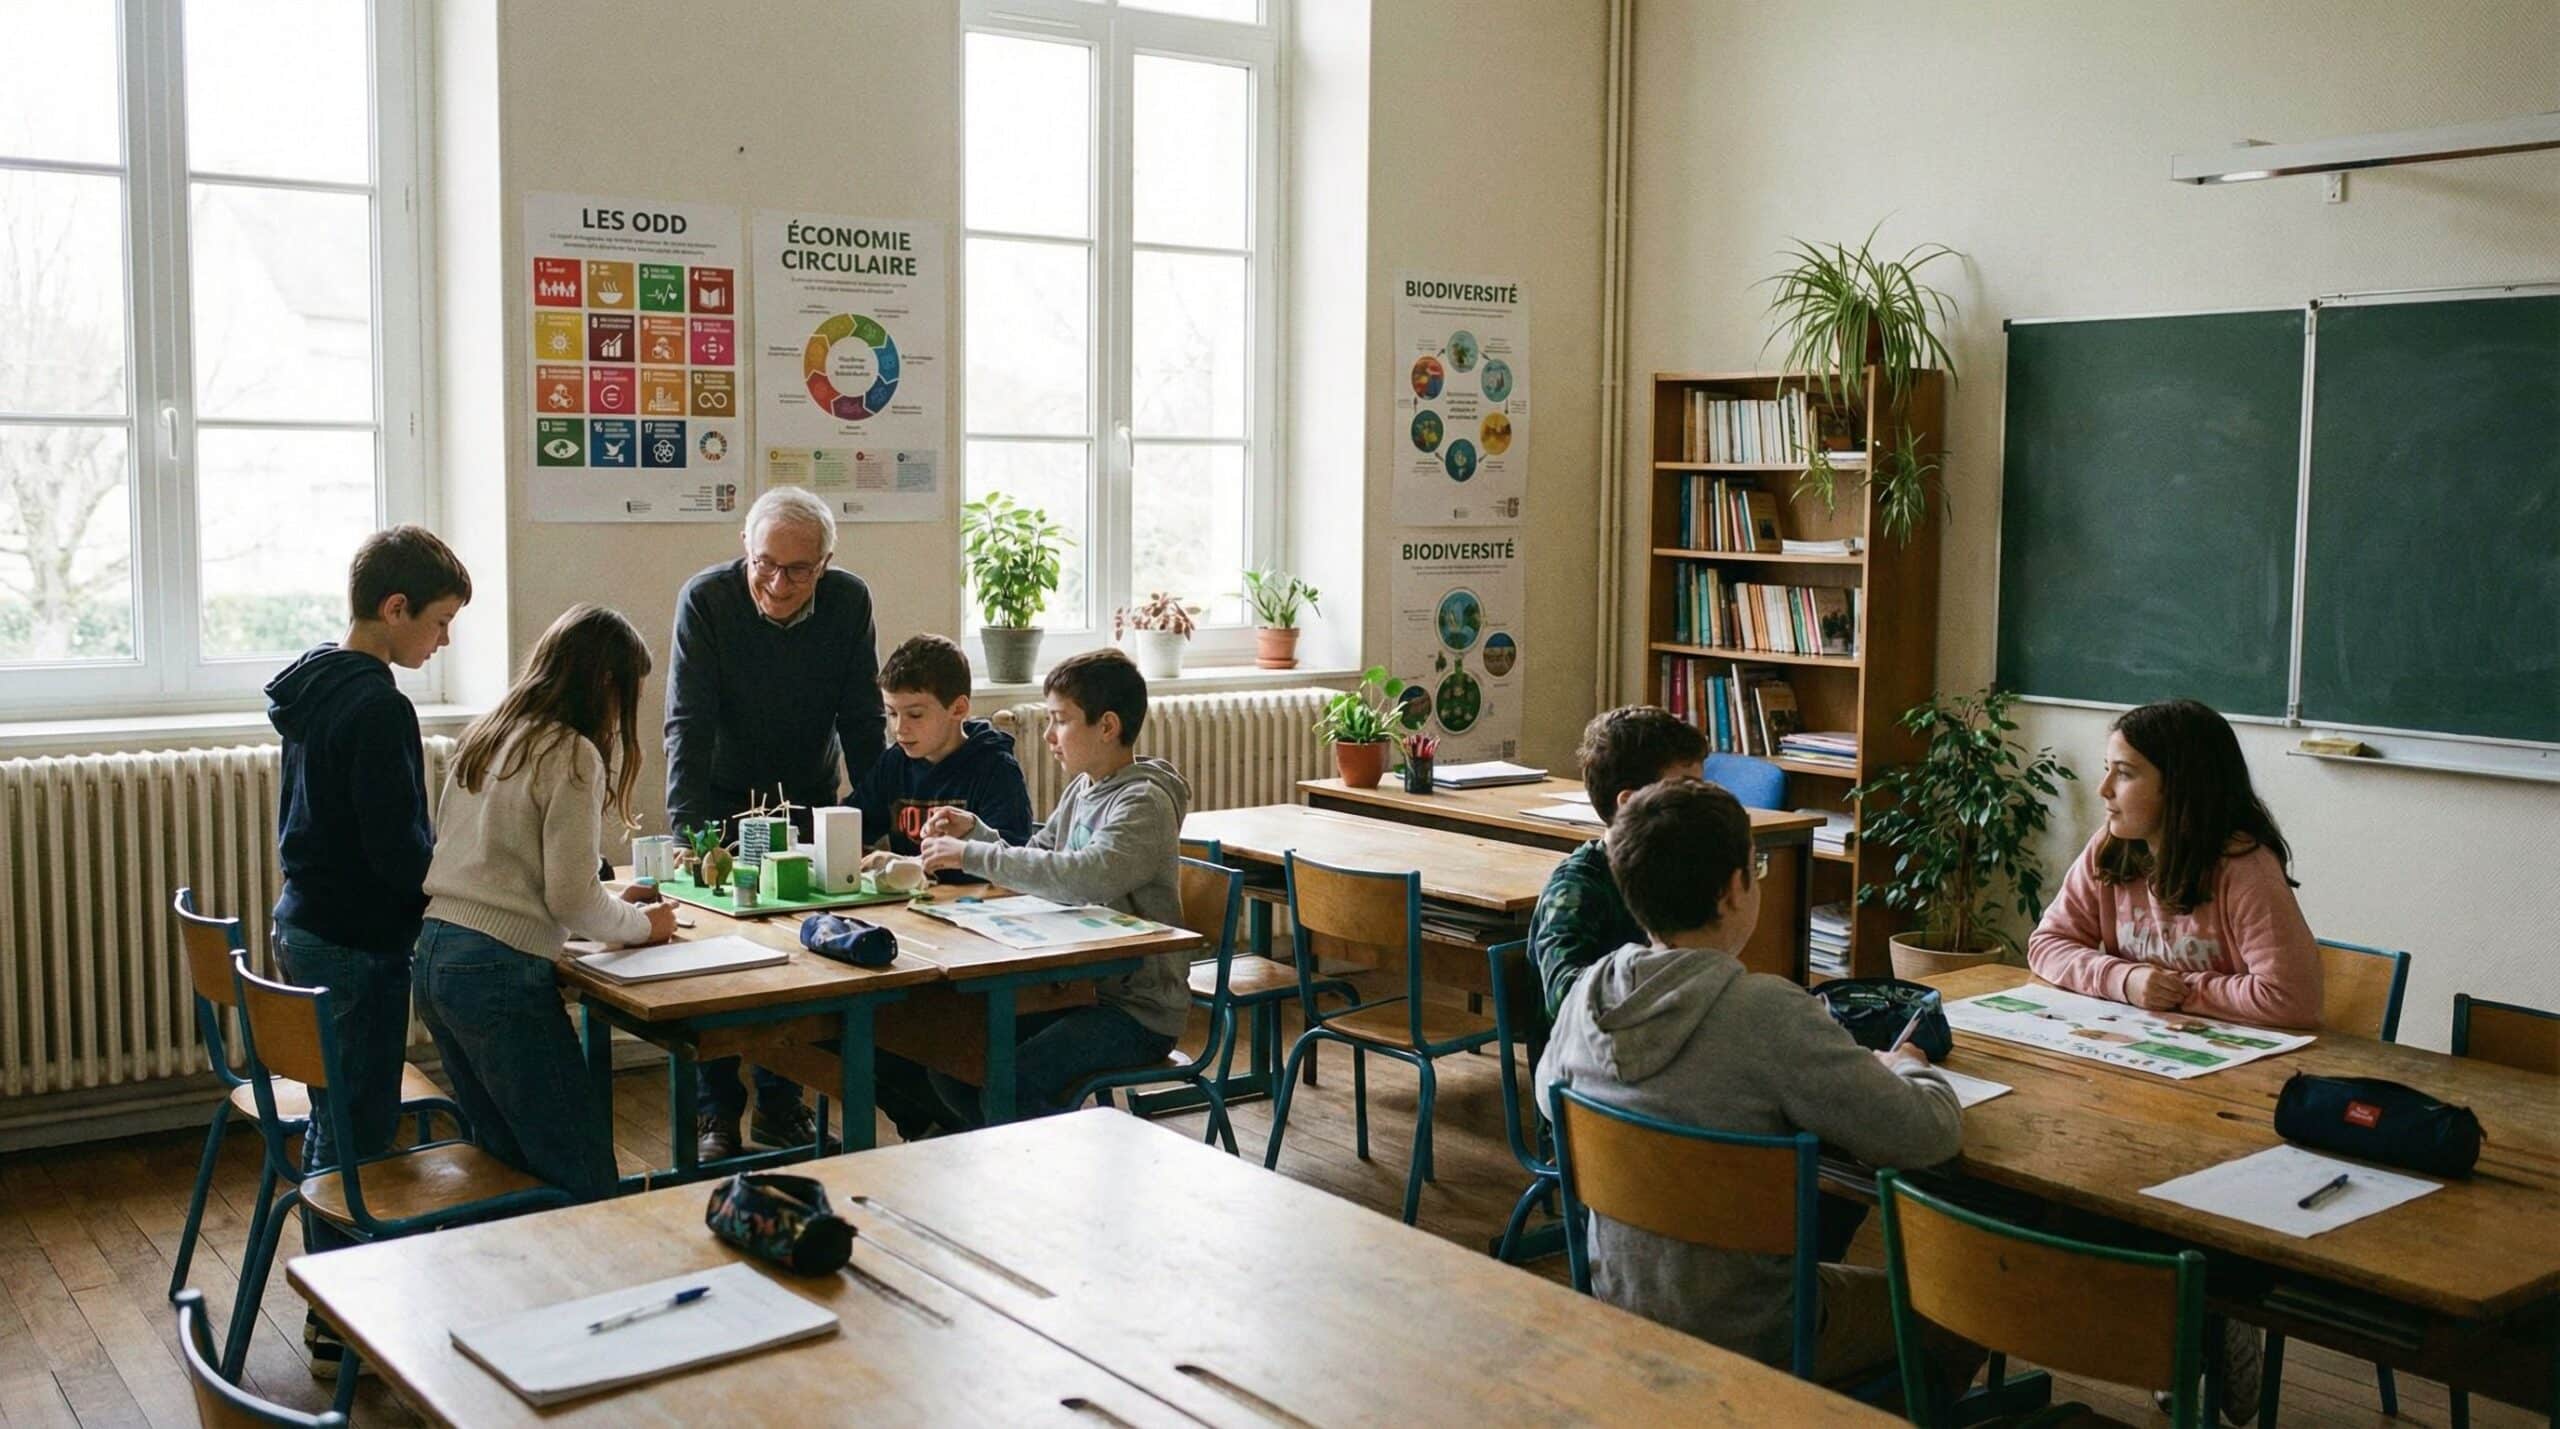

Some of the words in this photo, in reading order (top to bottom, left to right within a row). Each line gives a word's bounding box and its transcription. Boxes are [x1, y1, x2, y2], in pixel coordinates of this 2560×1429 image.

[582, 207, 625, 231] LES
[632, 211, 687, 235] ODD
[787, 219, 912, 252] ÉCONOMIE
[590, 264, 597, 276] 2
[781, 249, 917, 277] CIRCULAIRE
[693, 269, 700, 281] 4
[1405, 280, 1518, 304] BIODIVERSITÉ
[644, 422, 653, 433] 17
[1402, 538, 1515, 561] BIODIVERSITÉ
